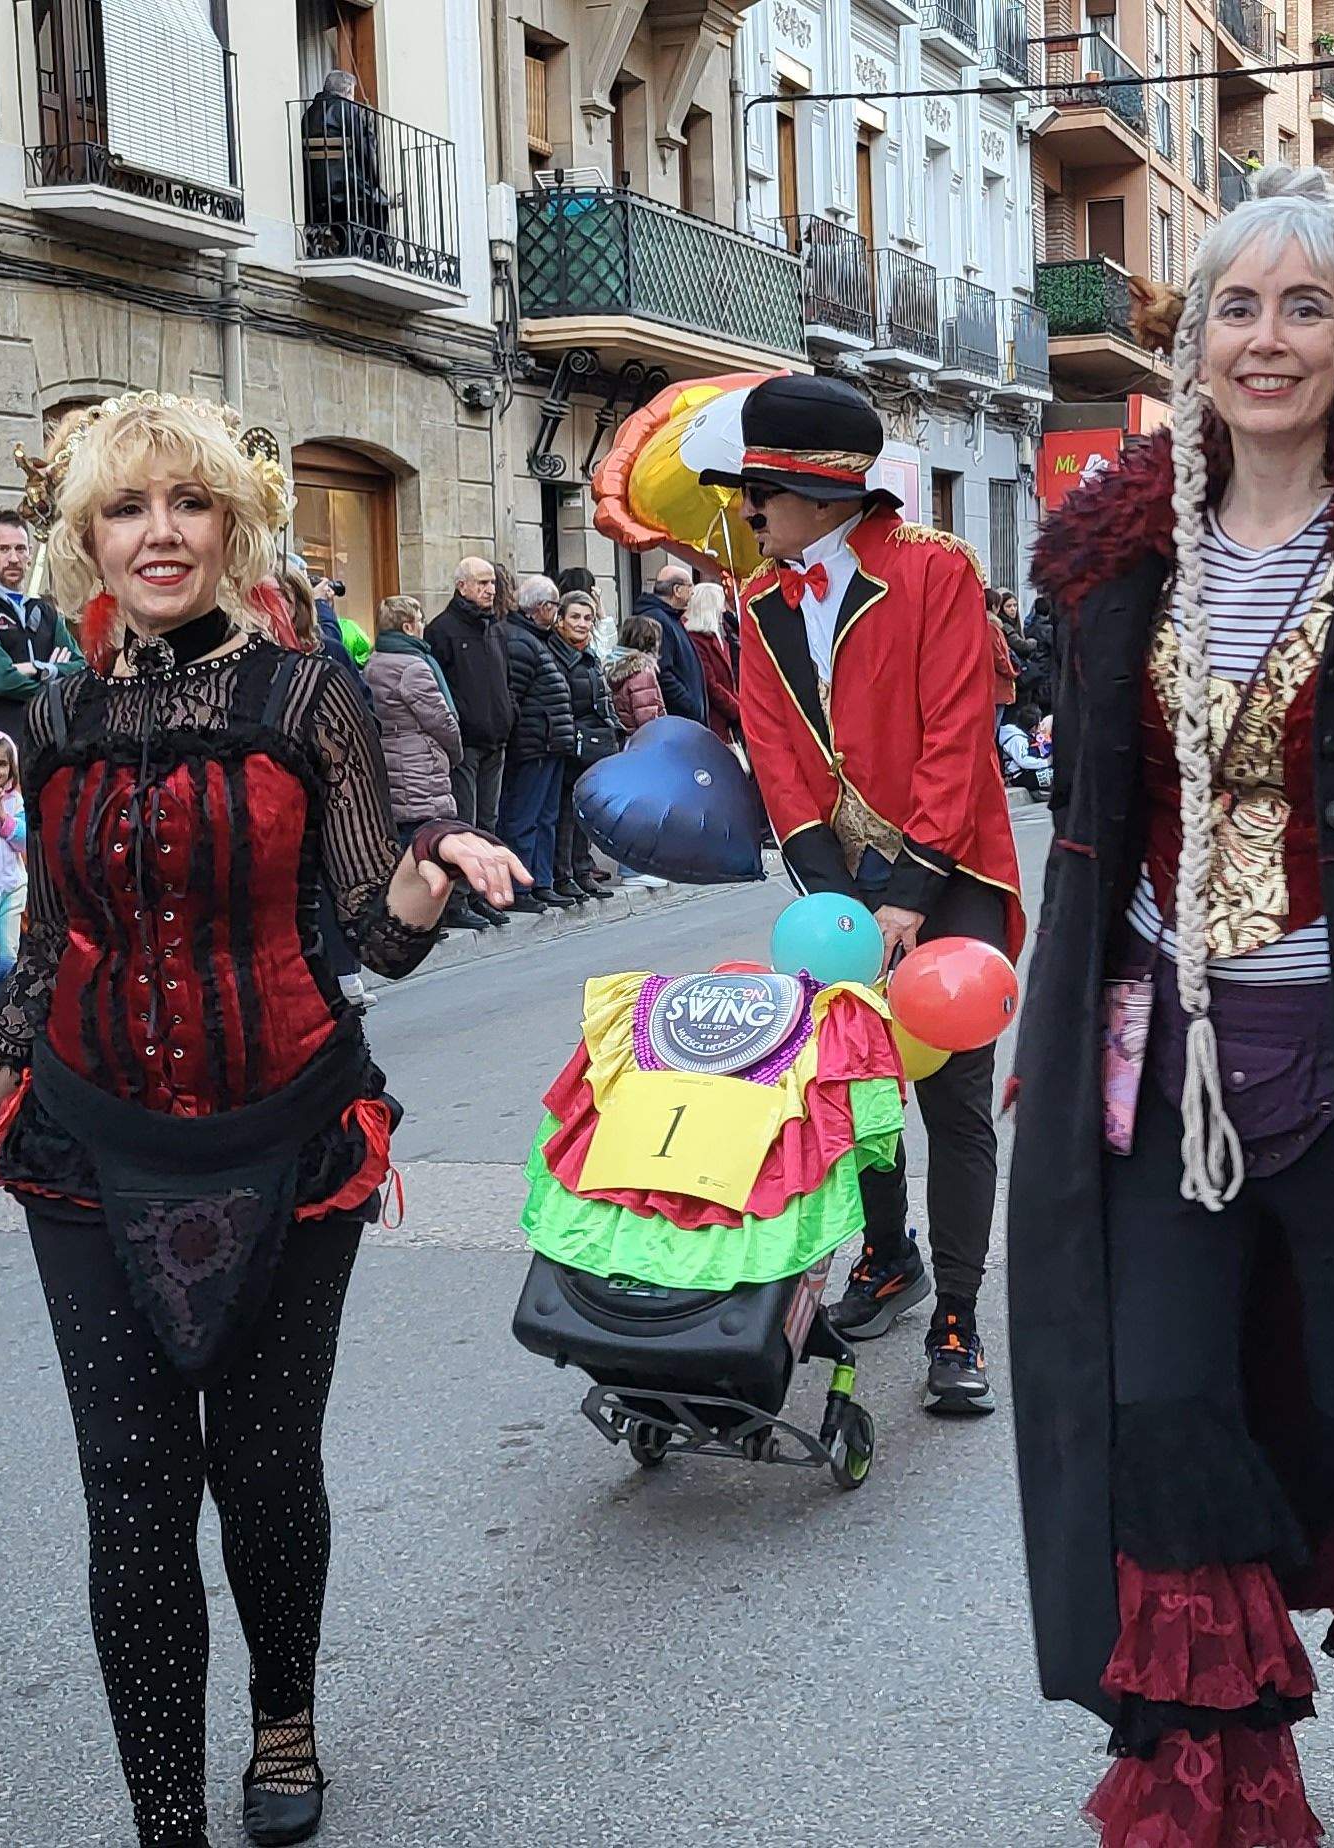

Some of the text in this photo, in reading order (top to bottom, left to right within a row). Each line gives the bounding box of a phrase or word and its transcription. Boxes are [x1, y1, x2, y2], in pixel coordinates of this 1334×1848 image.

[1054, 454, 1081, 476] Mi
[689, 985, 767, 1001] HUESCON
[665, 995, 777, 1027] SWING
[676, 1027, 705, 1051] HUESCA
[650, 1103, 688, 1159] 1
